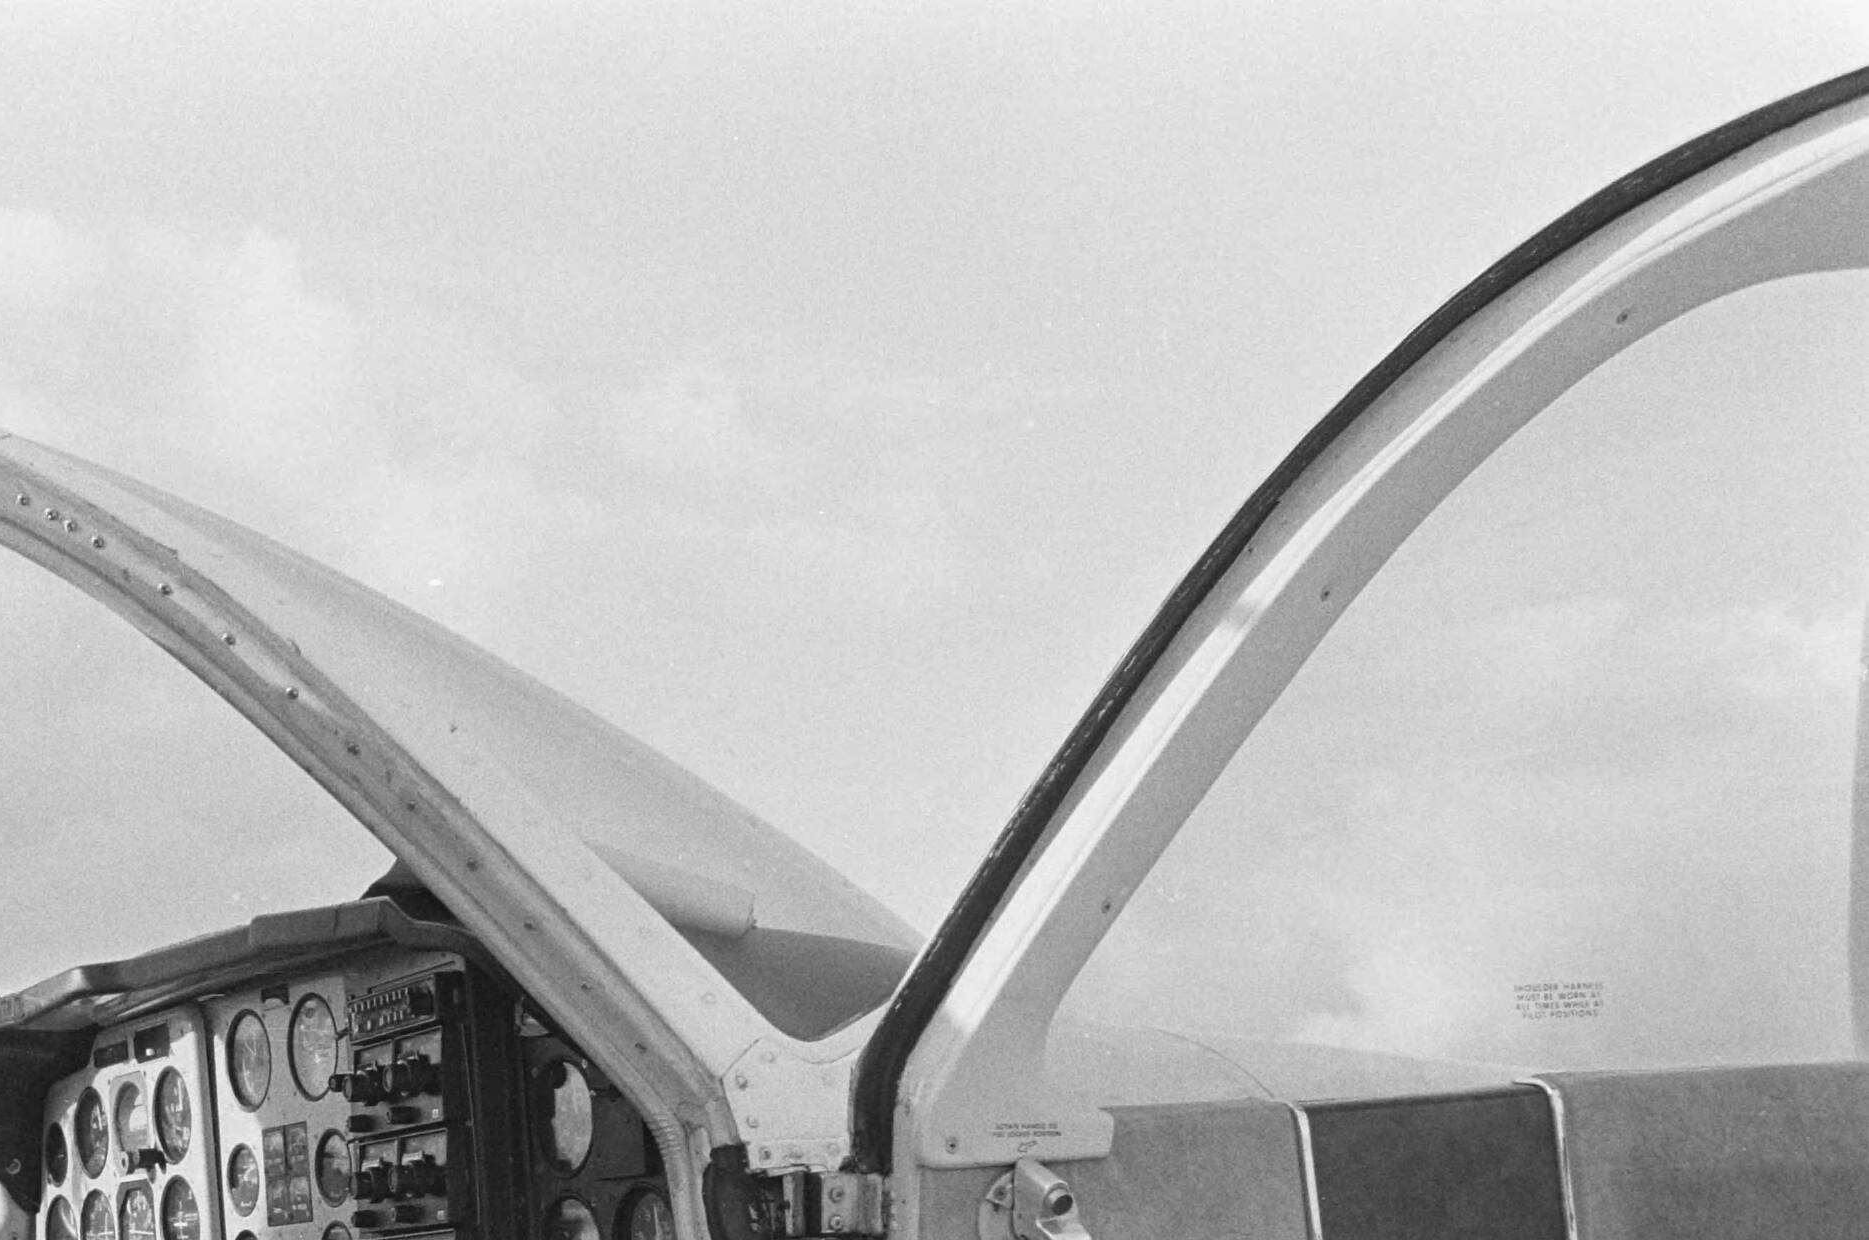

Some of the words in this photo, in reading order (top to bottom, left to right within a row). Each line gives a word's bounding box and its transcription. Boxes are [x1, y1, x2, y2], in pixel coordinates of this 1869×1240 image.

[1514, 983, 1558, 992] SHOULDER
[1563, 982, 1604, 990] HARNESS
[1516, 993, 1540, 1001] MUST
[1544, 993, 1553, 1001] BE
[1558, 992, 1587, 1000] WORN
[1535, 1002, 1560, 1010] TIMES
[1550, 1010, 1599, 1018] POSITIONS
